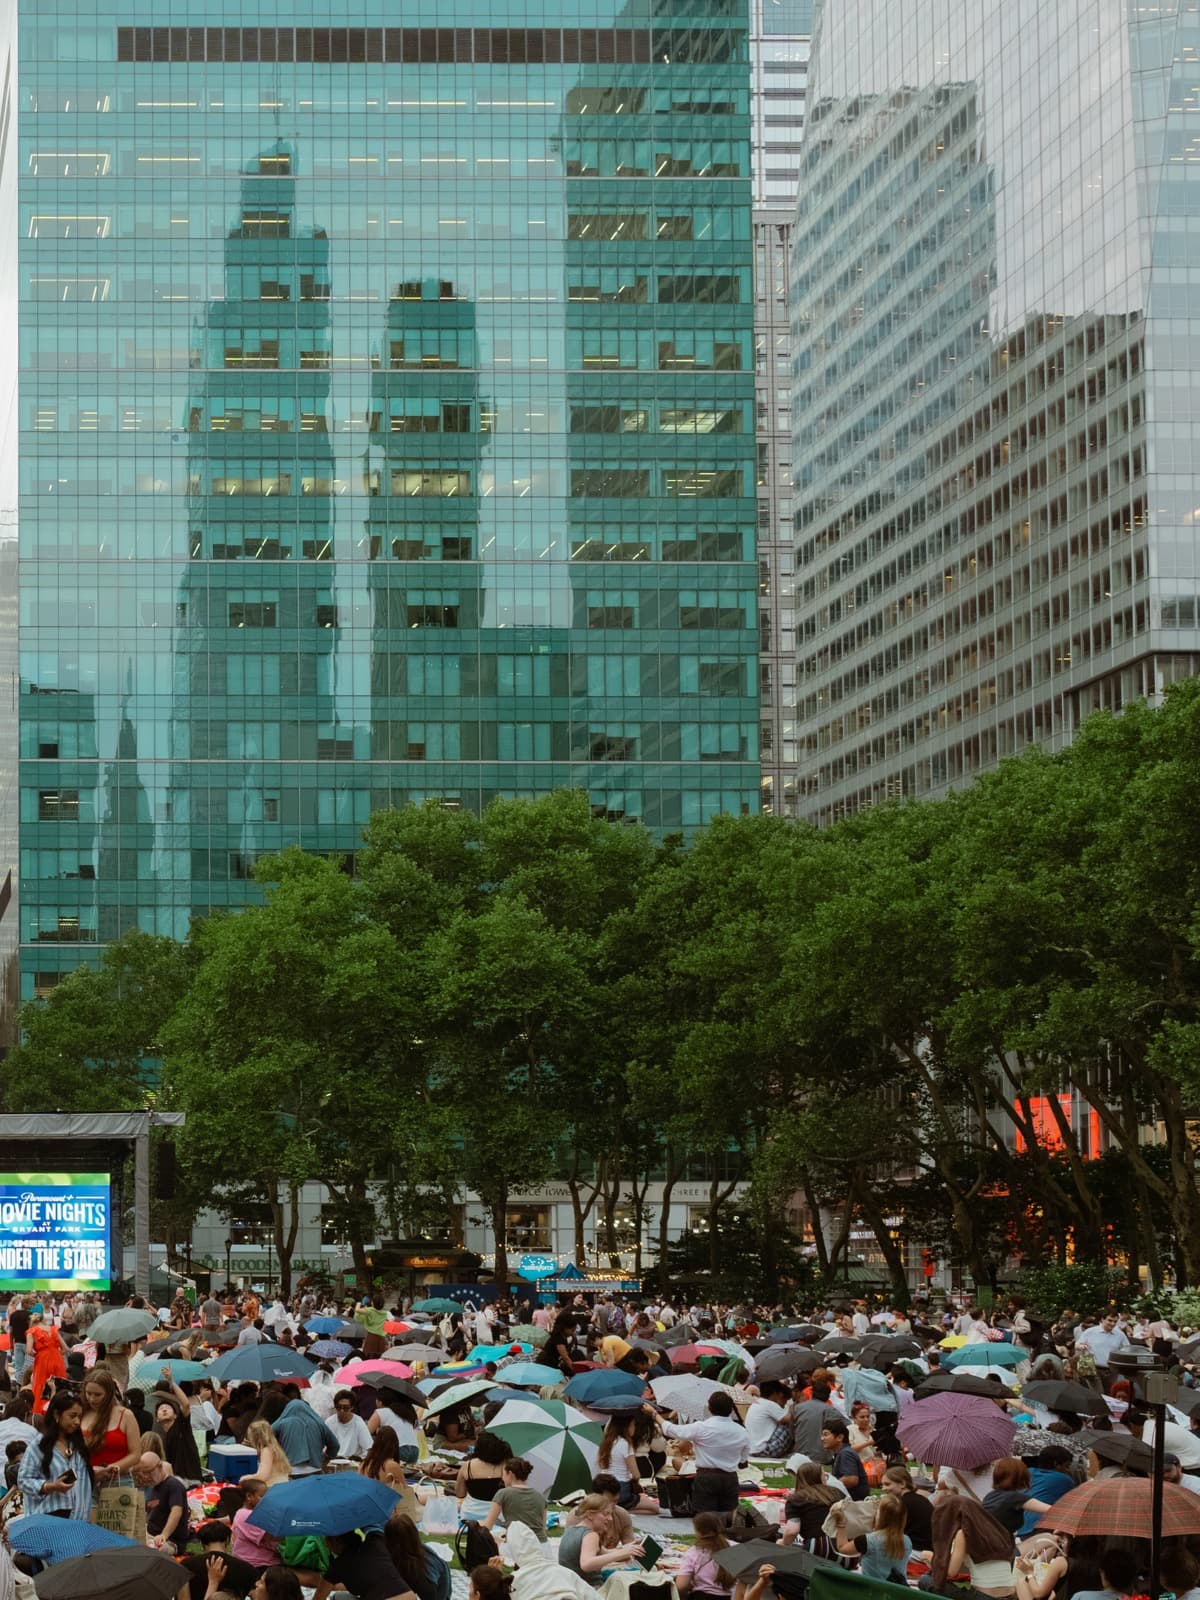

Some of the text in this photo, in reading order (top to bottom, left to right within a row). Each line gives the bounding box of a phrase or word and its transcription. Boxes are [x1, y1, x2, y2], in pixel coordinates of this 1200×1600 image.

[19, 1192, 74, 1202] Paramount+
[46, 1203, 105, 1227] NIGHTS
[36, 1248, 60, 1270] THE
[64, 1248, 105, 1270] STARS
[231, 1259, 272, 1271] FOODS
[273, 1259, 327, 1271] MRKET
